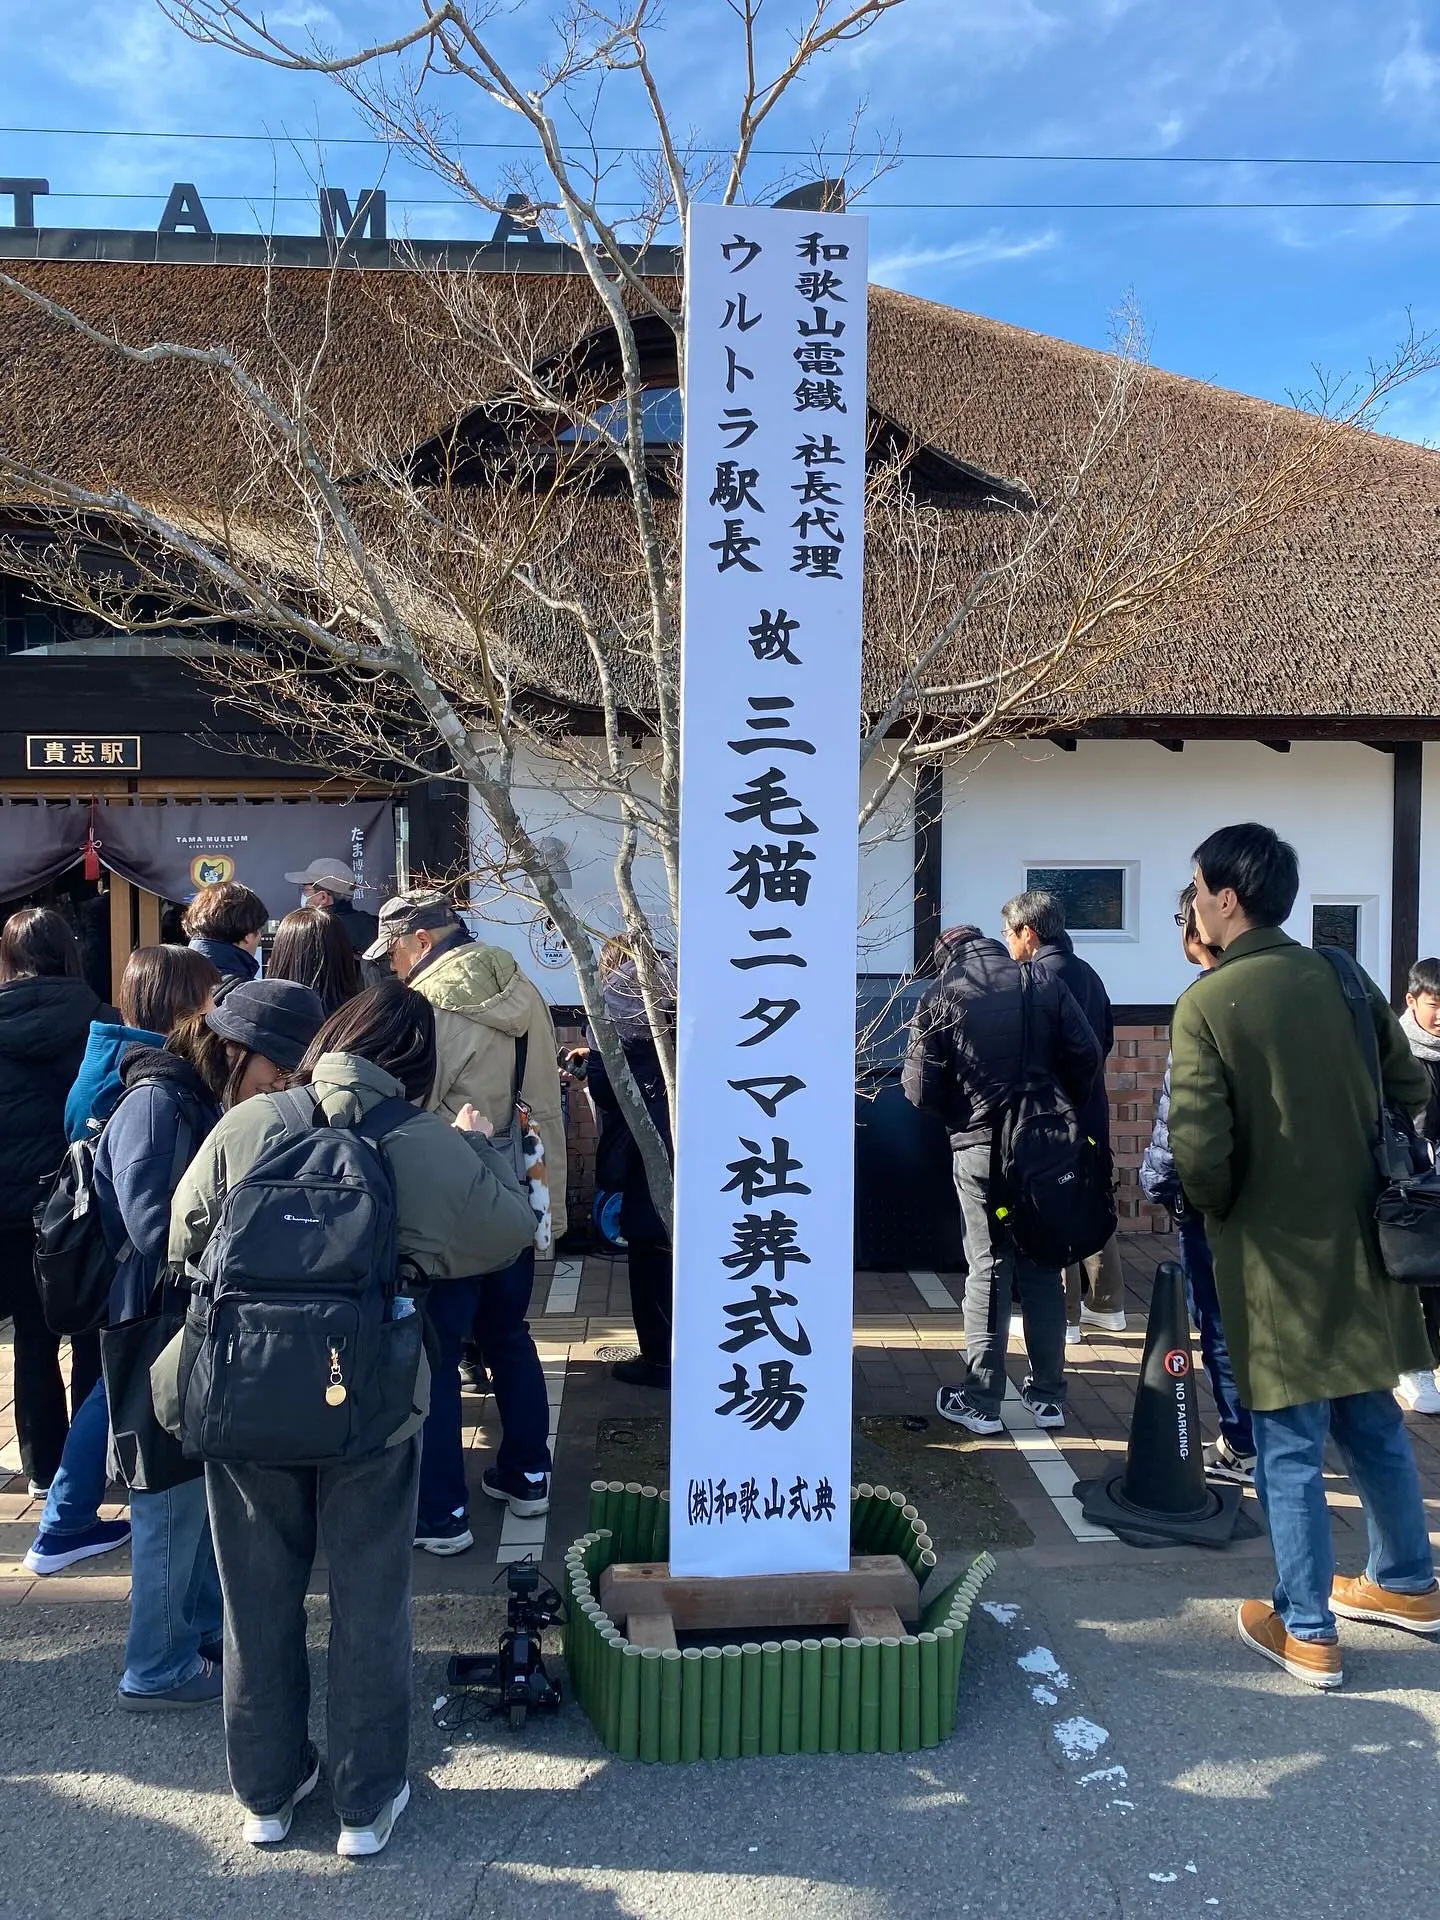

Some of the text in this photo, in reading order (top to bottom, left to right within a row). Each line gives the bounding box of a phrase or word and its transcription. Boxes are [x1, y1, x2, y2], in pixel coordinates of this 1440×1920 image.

[0, 178, 544, 243] TAMA
[708, 233, 766, 574] ウルトラ駅長
[789, 432, 846, 580] 社長代理
[43, 741, 124, 764] 貴志駅
[1175, 1382, 1186, 1401] NO
[687, 1475, 836, 1526] (株)和歌山式典
